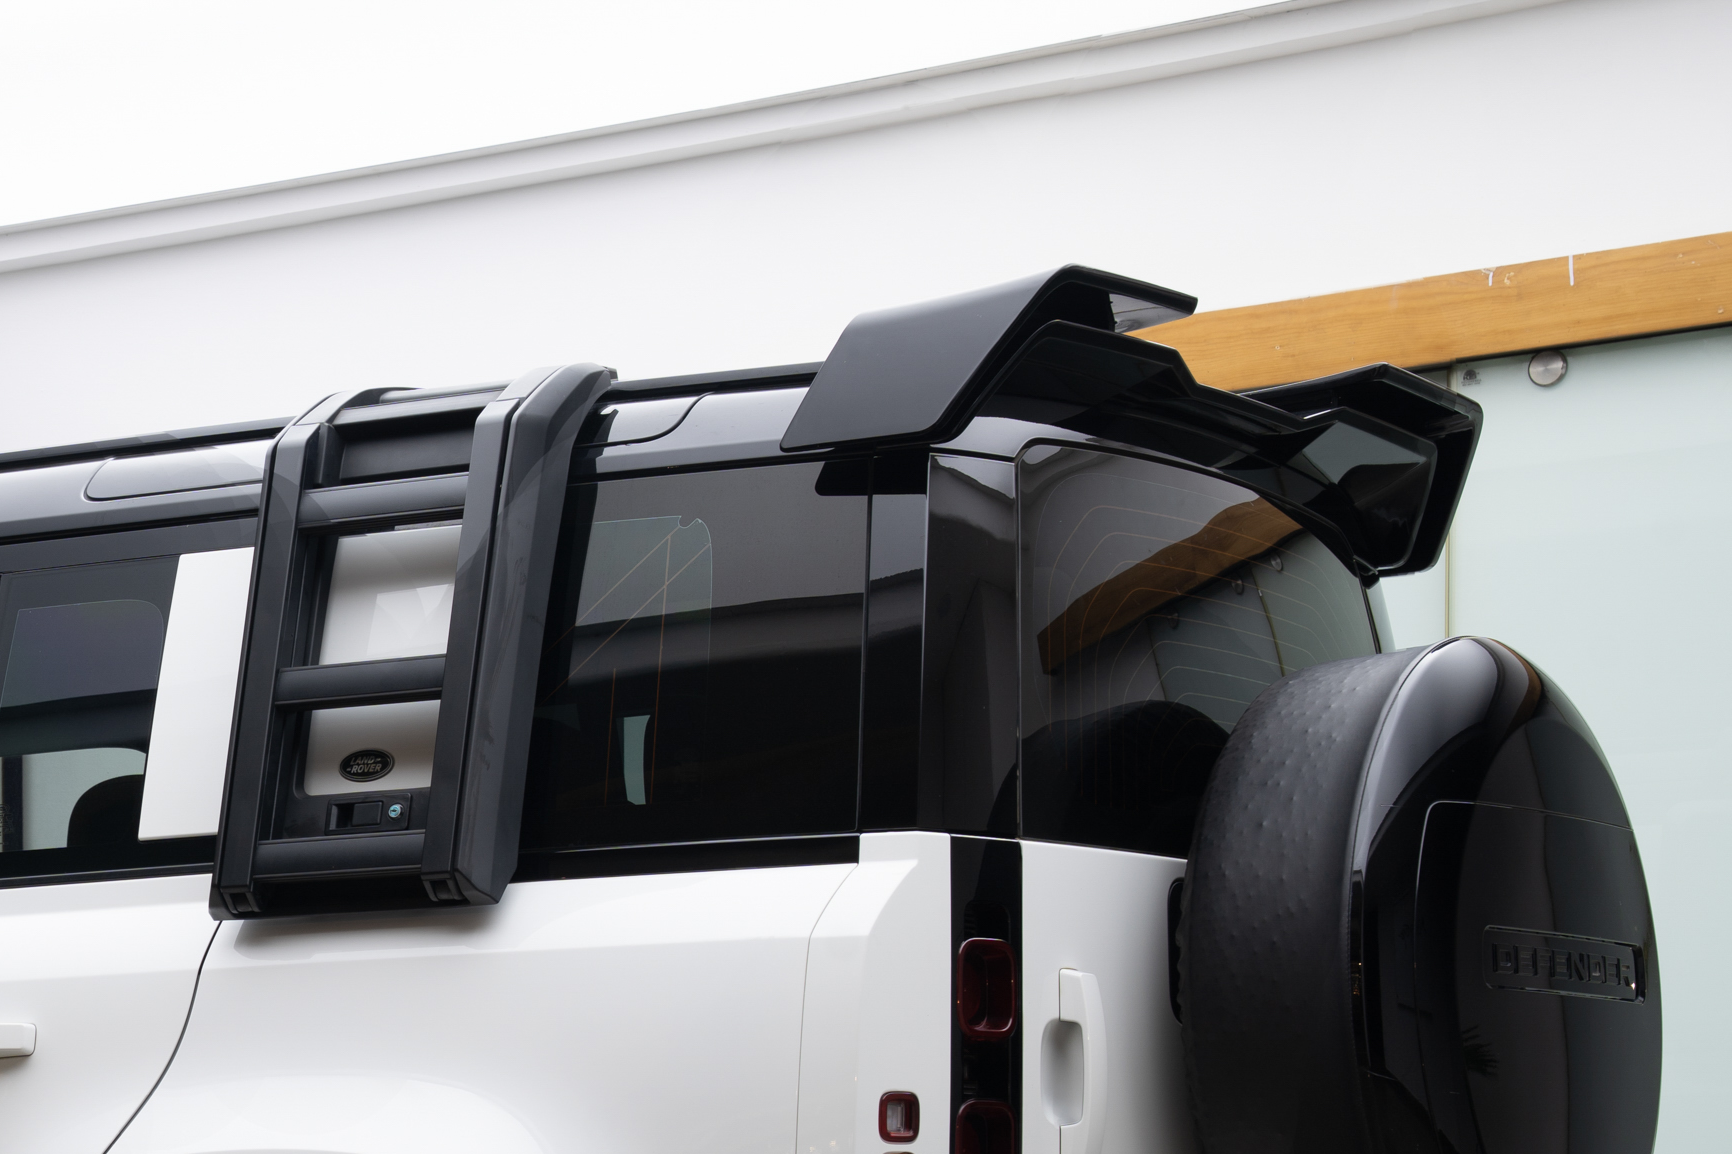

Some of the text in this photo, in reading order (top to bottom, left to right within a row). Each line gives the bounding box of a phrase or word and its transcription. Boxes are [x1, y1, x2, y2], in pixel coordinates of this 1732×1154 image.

[350, 755, 375, 765] LAND
[350, 763, 382, 774] ROVER
[1491, 942, 1635, 988] DEFENDER
